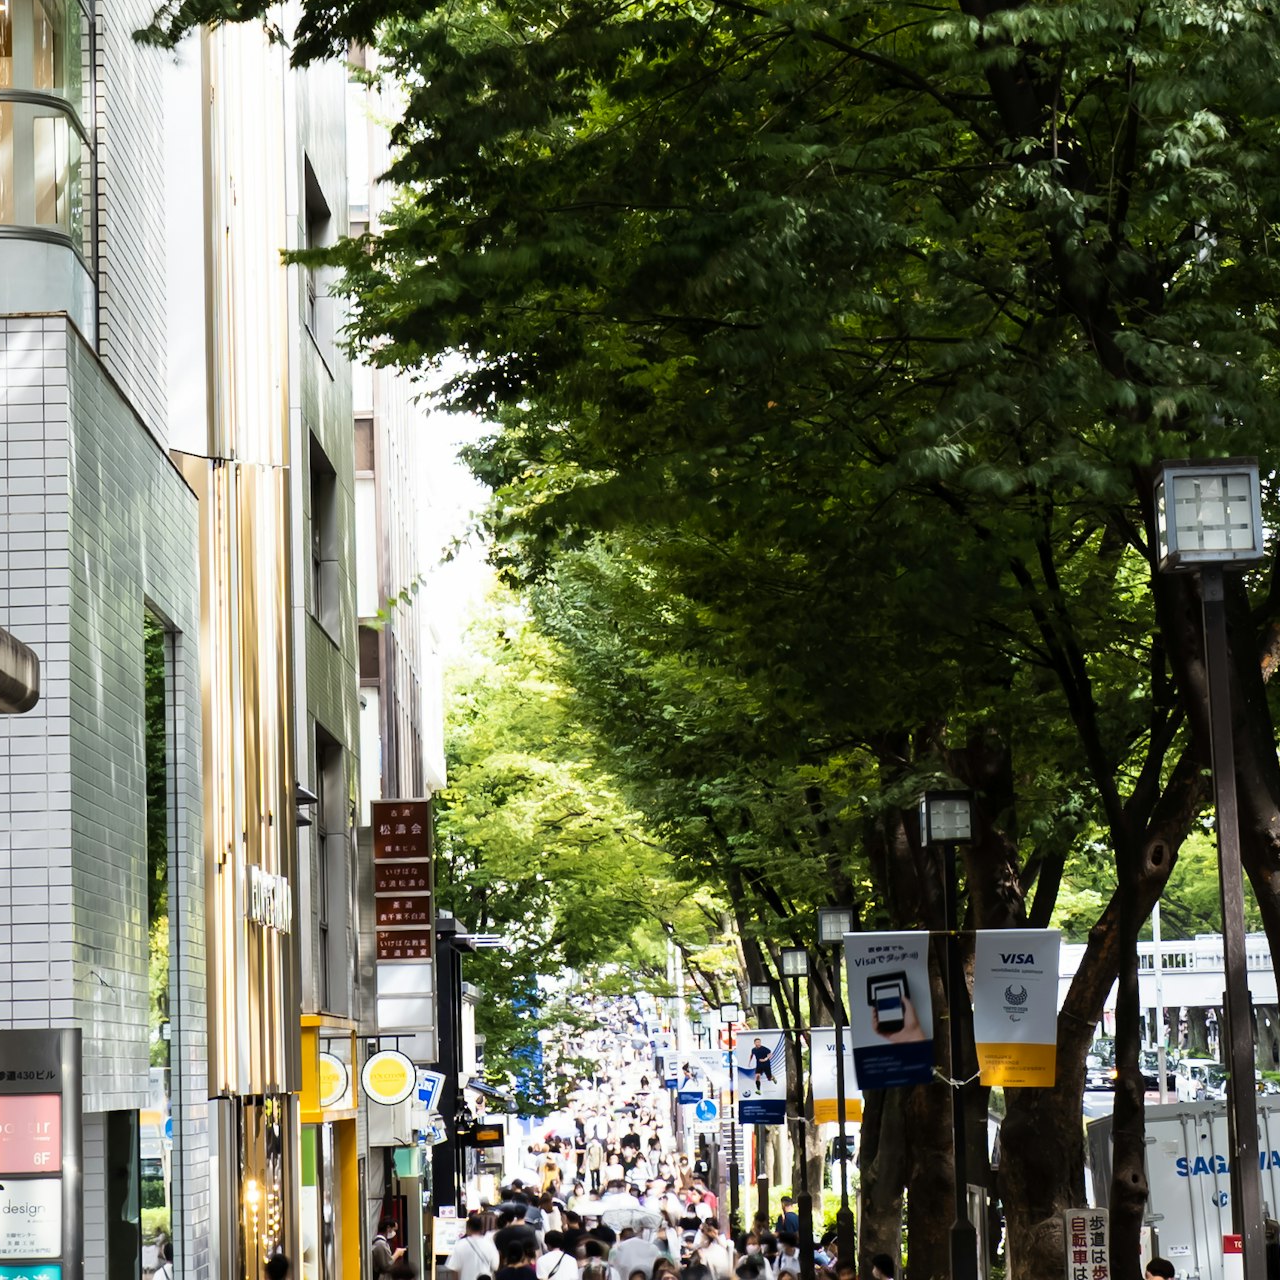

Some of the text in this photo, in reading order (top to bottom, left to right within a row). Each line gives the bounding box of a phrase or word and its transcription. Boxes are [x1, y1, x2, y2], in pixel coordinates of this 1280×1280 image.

[999, 953, 1034, 965] VISA
[34, 1152, 51, 1165] 6F
[3, 1199, 46, 1217] design
